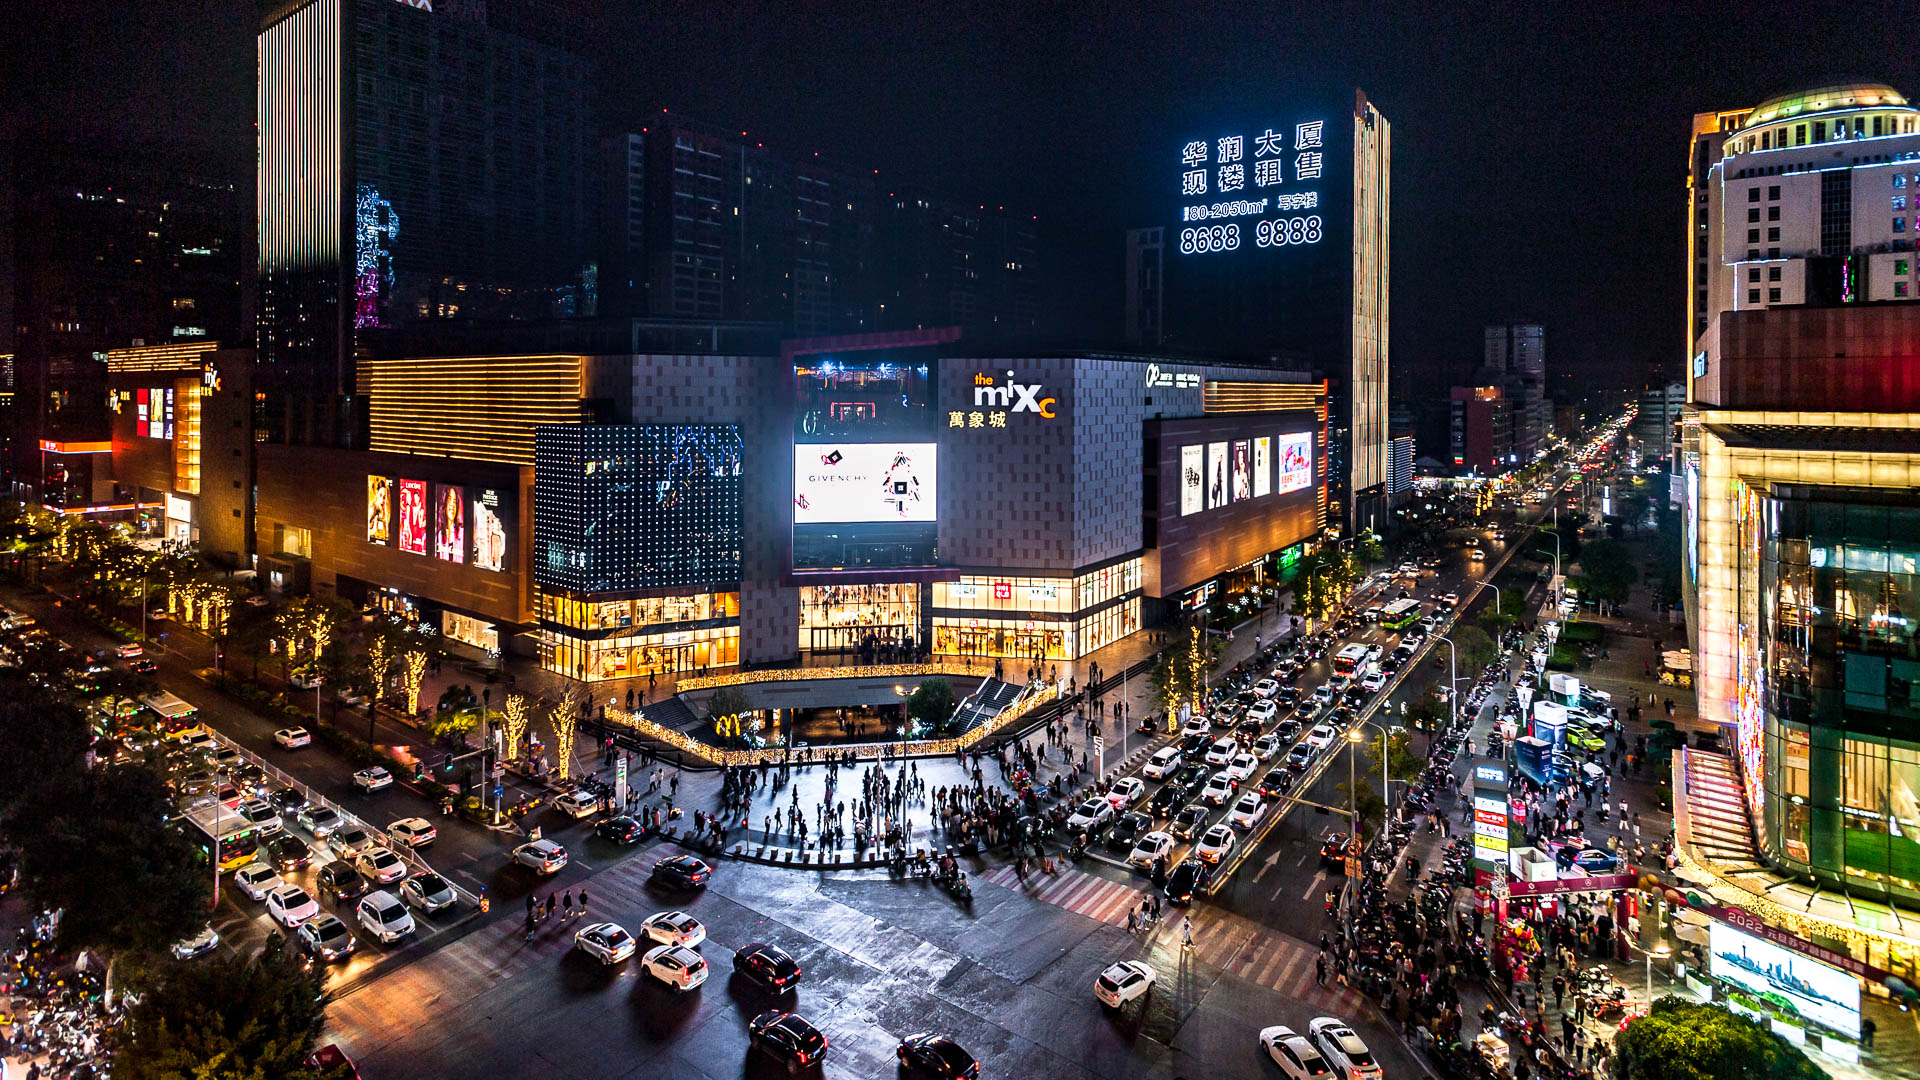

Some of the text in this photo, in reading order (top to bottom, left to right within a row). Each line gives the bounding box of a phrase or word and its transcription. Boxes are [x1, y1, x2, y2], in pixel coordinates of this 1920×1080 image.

[1182, 120, 1324, 168] 华润大厦
[1182, 151, 1323, 196] 现楼租售
[1278, 192, 1318, 210] 写字楼
[1181, 215, 1322, 254] 8688 9888
[975, 372, 994, 386] the
[949, 411, 1006, 429] 萬象城
[1728, 912, 1763, 934] 2022
